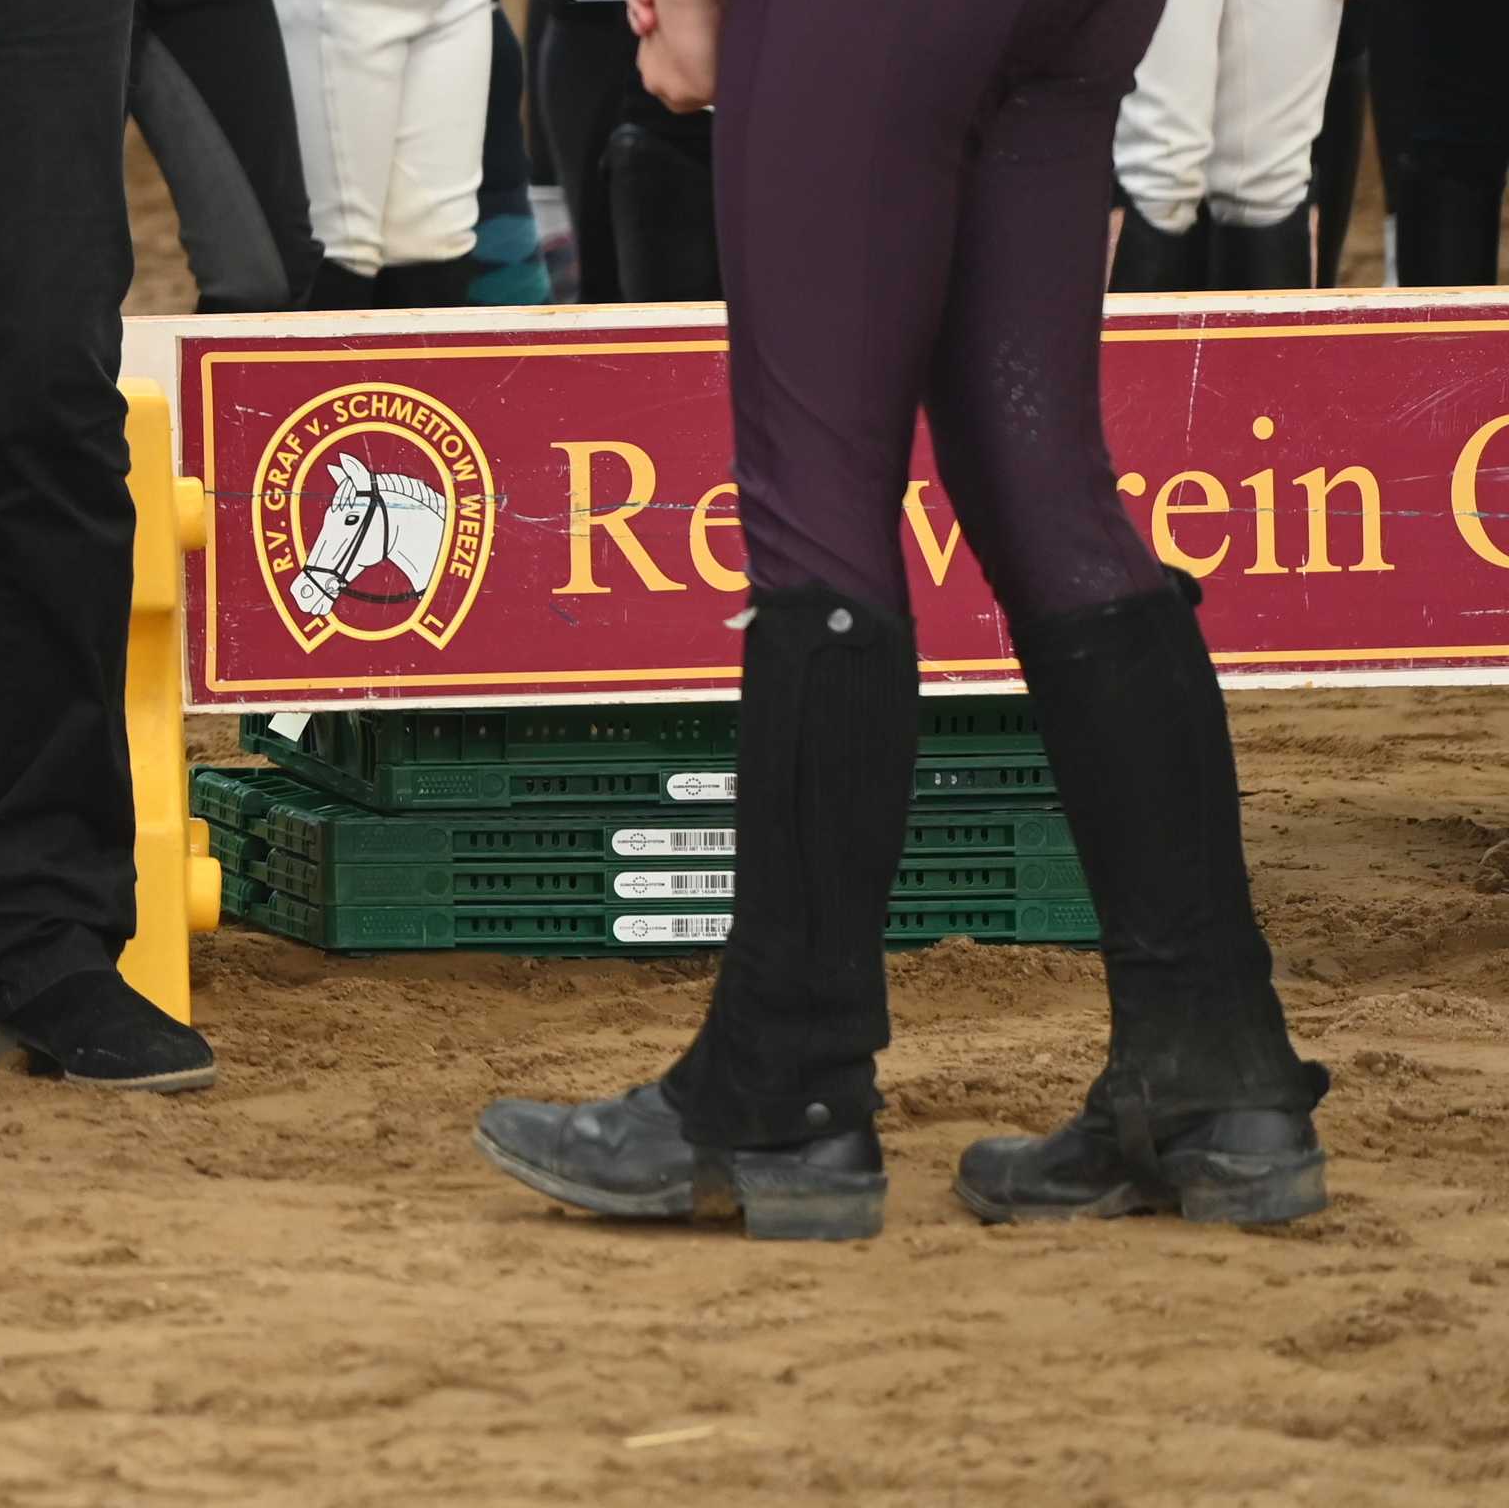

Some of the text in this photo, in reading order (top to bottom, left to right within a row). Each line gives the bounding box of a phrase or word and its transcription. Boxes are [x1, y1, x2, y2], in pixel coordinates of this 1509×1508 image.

[264, 433, 305, 511] GRAF
[332, 394, 478, 483] SCHMETTOW
[449, 495, 482, 581] WEEZE
